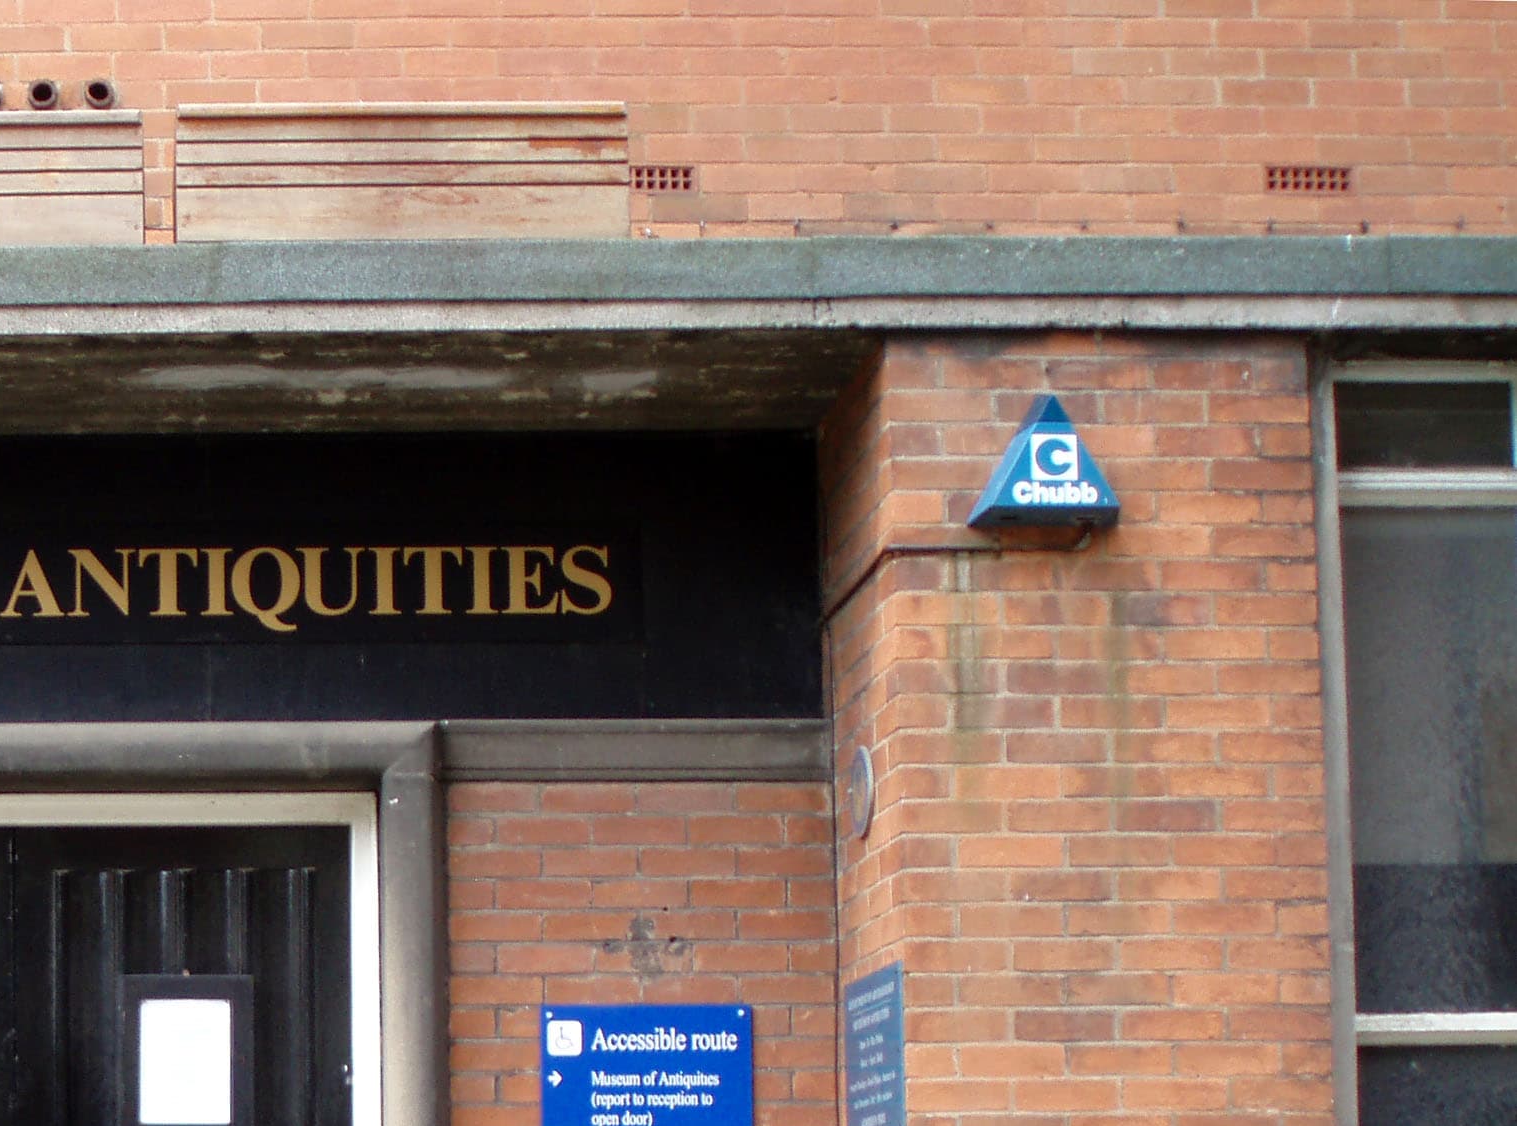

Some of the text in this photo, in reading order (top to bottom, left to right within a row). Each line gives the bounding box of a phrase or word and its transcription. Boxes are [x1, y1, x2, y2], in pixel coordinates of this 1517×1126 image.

[1012, 480, 1098, 504] Chubb
[0, 544, 611, 632] ANTIQUITIES
[590, 1027, 739, 1051] Accessible route
[591, 1070, 721, 1090] Museum of Antiquities
[591, 1090, 714, 1110] (report to reception to
